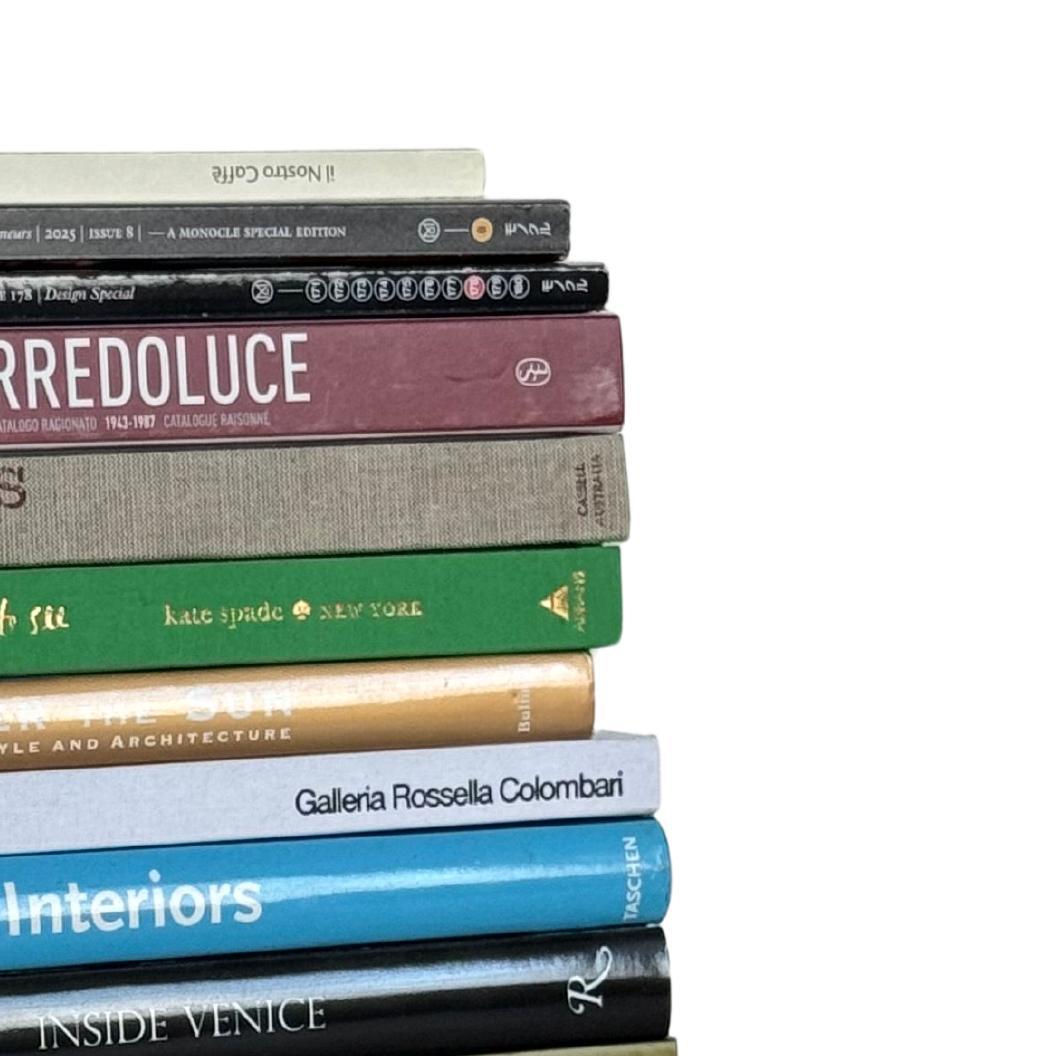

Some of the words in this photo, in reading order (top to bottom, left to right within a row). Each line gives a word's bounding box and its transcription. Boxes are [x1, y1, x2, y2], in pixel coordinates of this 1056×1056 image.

[262, 165, 321, 182] Nostro
[326, 164, 335, 183] il
[45, 228, 76, 242] 2025
[89, 227, 122, 240] ISSUE
[126, 225, 134, 240] 8
[166, 226, 177, 239] A
[178, 226, 242, 239] MONOCLE
[244, 226, 293, 239] SPECIAL
[296, 225, 347, 238] EDITION
[11, 287, 33, 303] 178
[44, 287, 87, 304] Design
[90, 285, 136, 304] Special
[40, 415, 97, 432] RAGIONATO
[105, 414, 156, 430] 1943-1987
[163, 412, 219, 428] CATALOGUE
[29, 603, 71, 636] see
[163, 603, 214, 626] kate
[219, 600, 285, 630] spade
[318, 602, 364, 621] NEW
[369, 600, 424, 618] YORK
[184, 685, 294, 723] SUN
[51, 738, 100, 752] AND
[109, 727, 292, 750] ARCHITECTURE
[294, 784, 387, 817] Galleria
[393, 779, 494, 811] Rossella
[499, 769, 625, 804] Colombari
[621, 835, 643, 922] TASCHEN
[3, 867, 266, 936] Interiors
[36, 1006, 170, 1051] INSIDE
[183, 995, 328, 1040] VENICE
